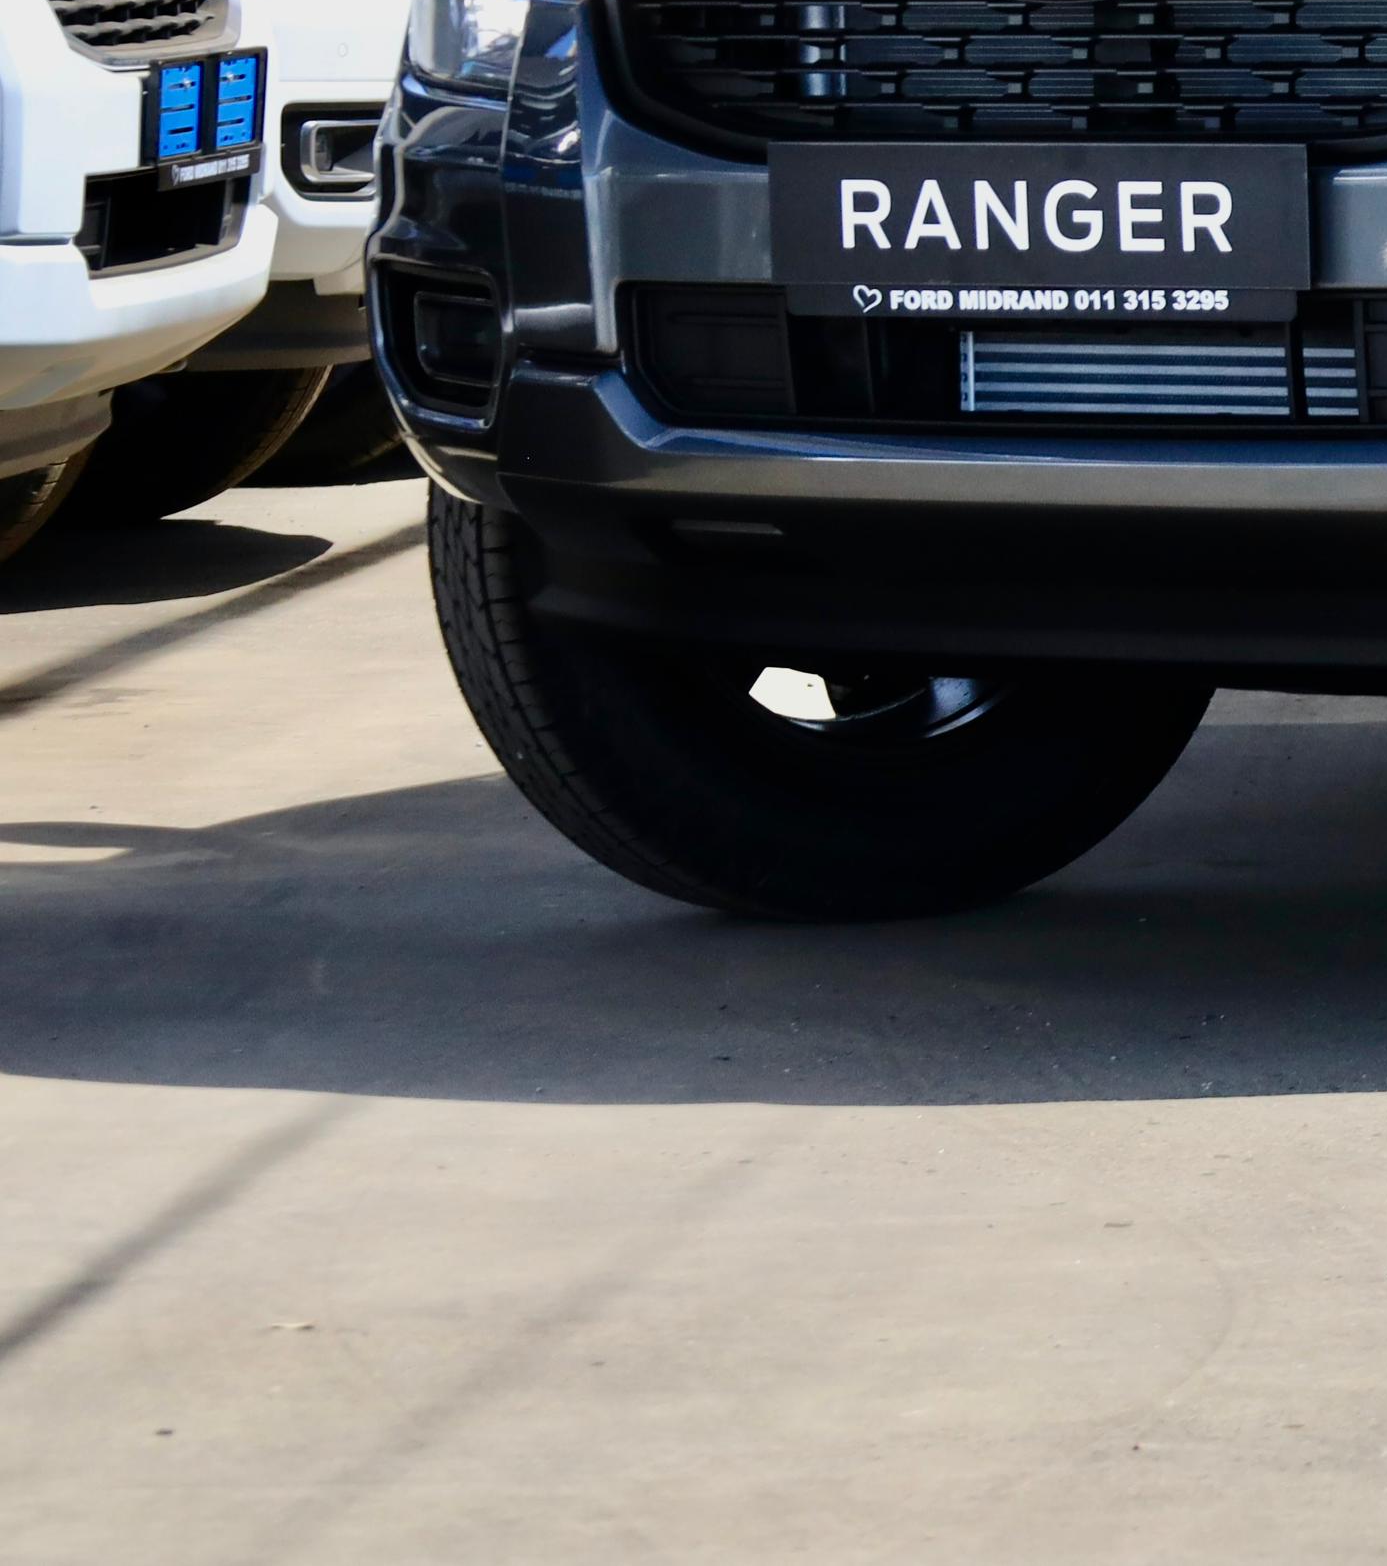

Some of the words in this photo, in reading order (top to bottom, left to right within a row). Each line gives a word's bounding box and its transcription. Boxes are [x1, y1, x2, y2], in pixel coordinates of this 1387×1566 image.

[839, 178, 1233, 253] RANGER
[889, 289, 954, 311] FORD
[958, 289, 1069, 311] MIDRAND
[1073, 289, 1116, 311] 011
[1122, 289, 1167, 311] 315
[1171, 289, 1230, 311] 3295
